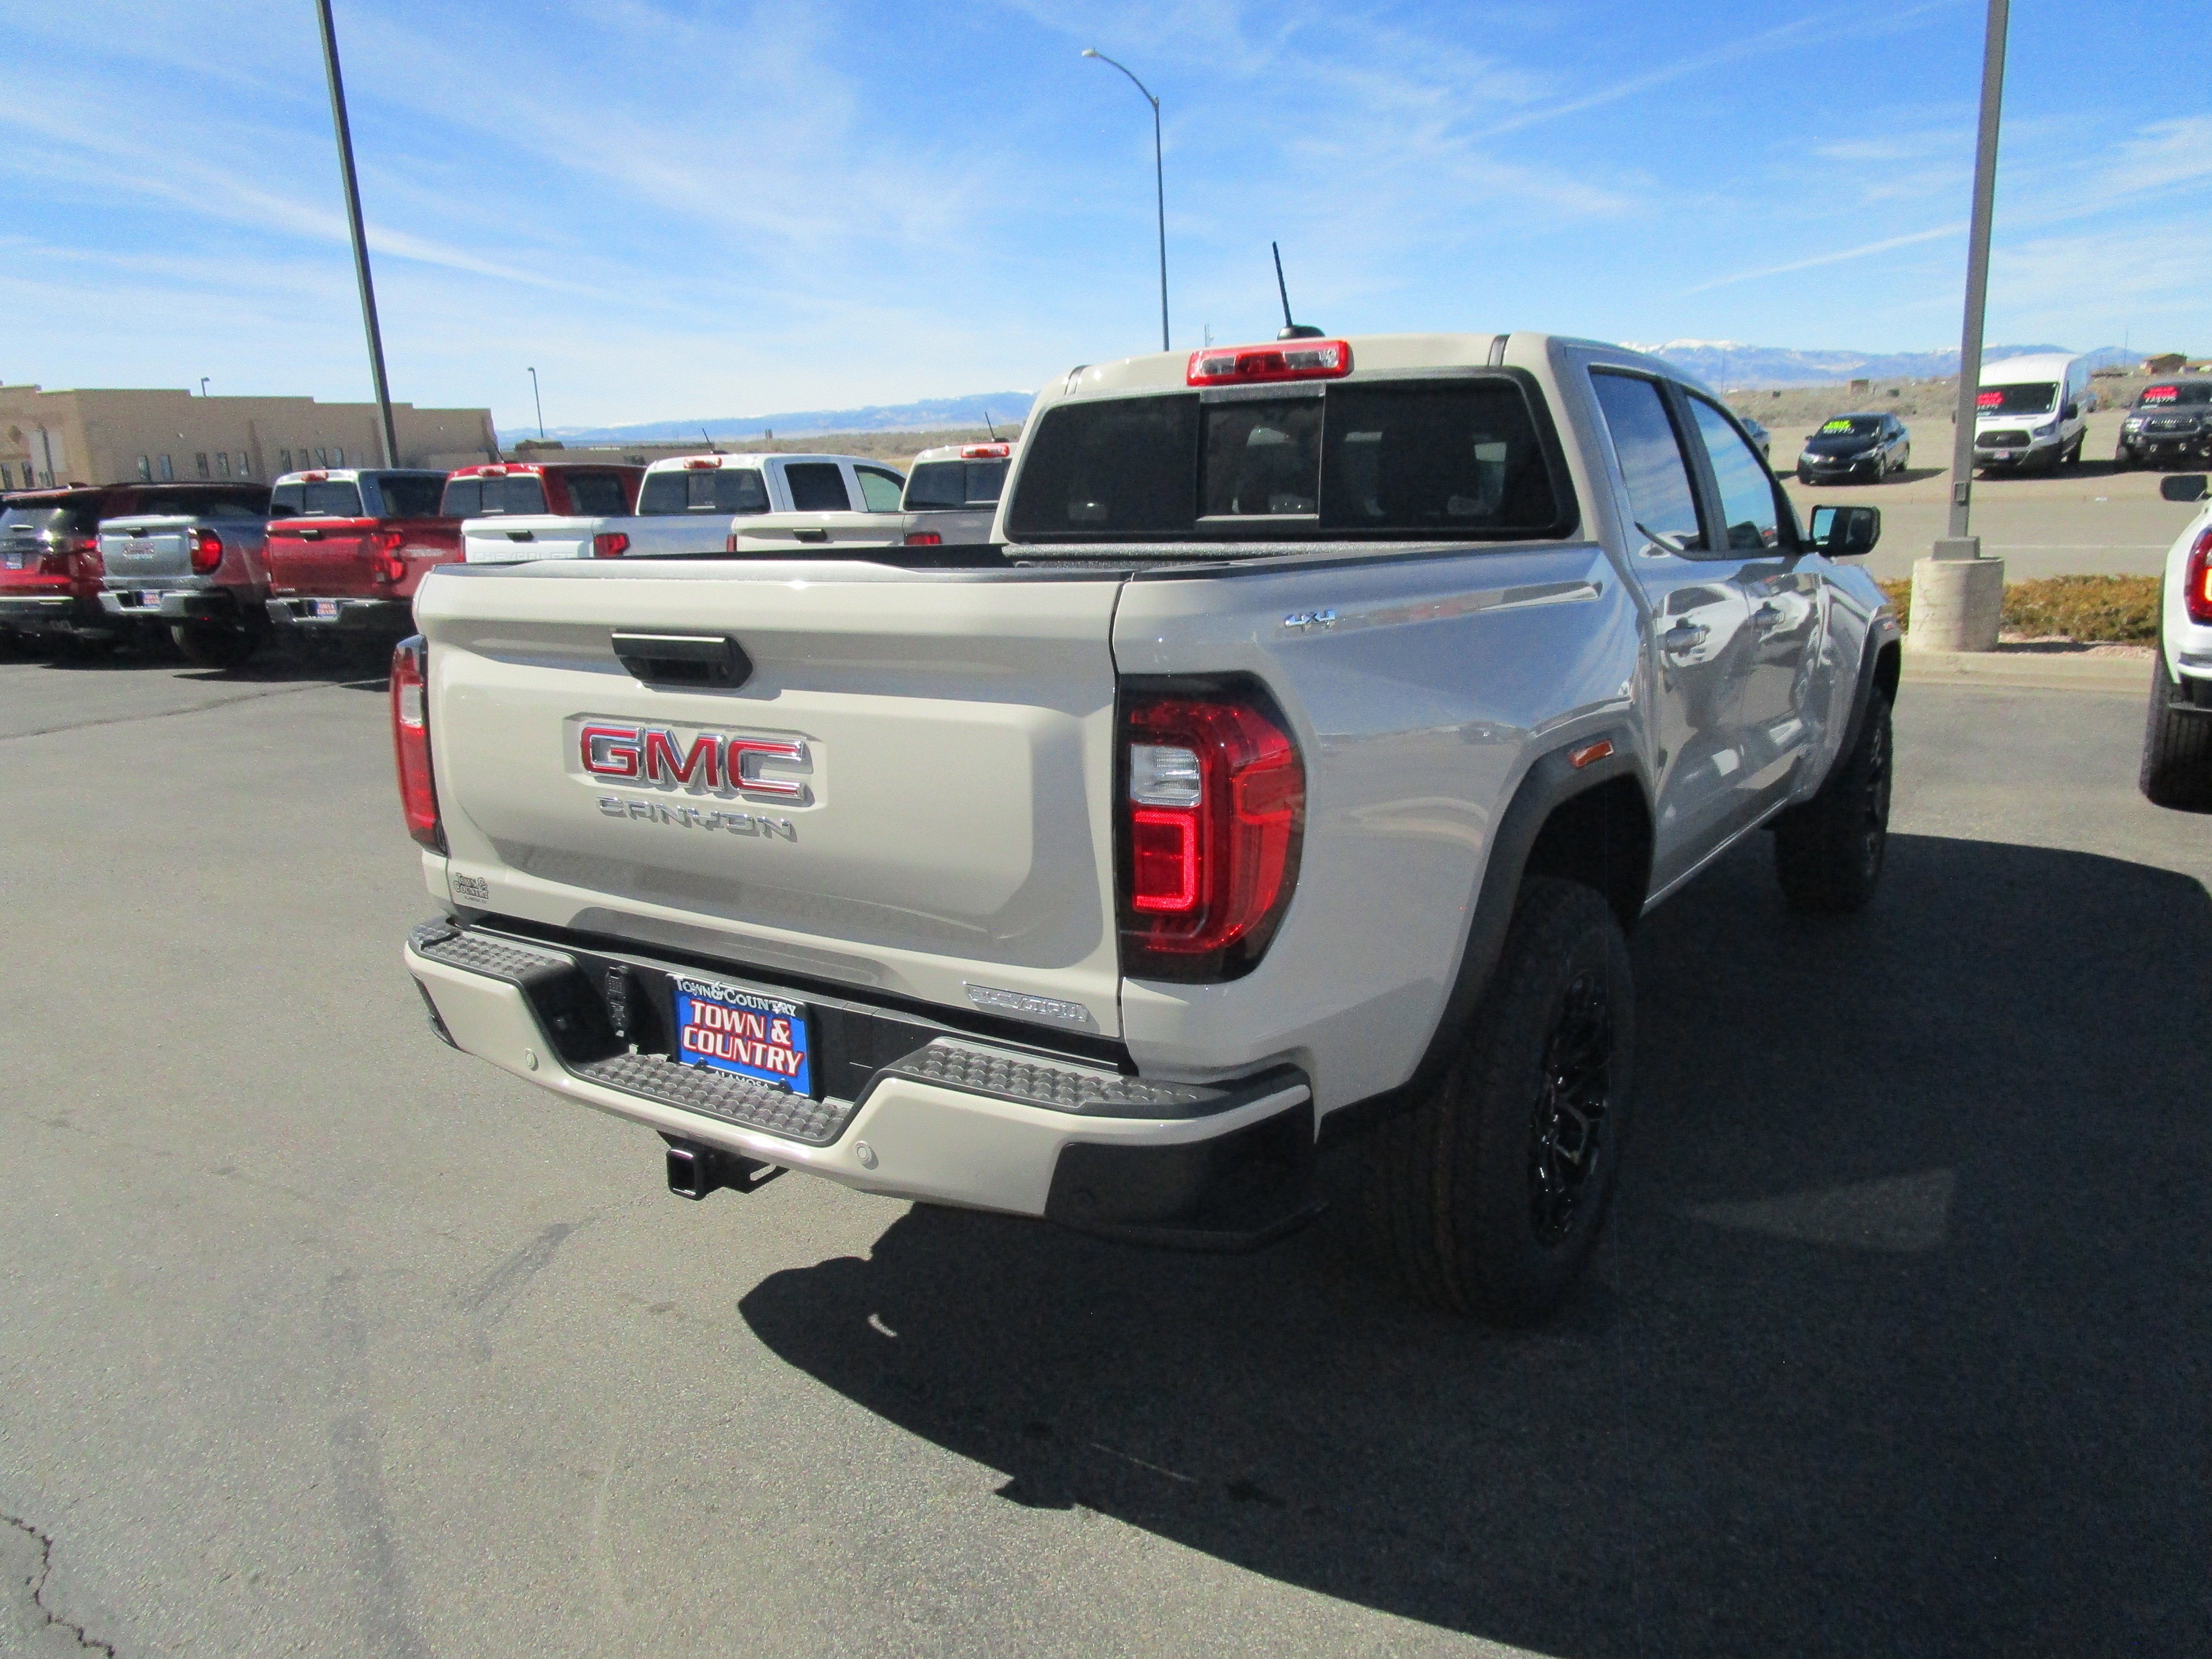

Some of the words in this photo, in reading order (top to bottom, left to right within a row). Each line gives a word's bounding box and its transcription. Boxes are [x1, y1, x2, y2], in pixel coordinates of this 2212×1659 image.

[581, 722, 805, 800] GMC
[598, 796, 793, 838] CANYON
[690, 999, 766, 1040] TOWN
[770, 1018, 792, 1047] &
[683, 1025, 804, 1076] COUNTRY
